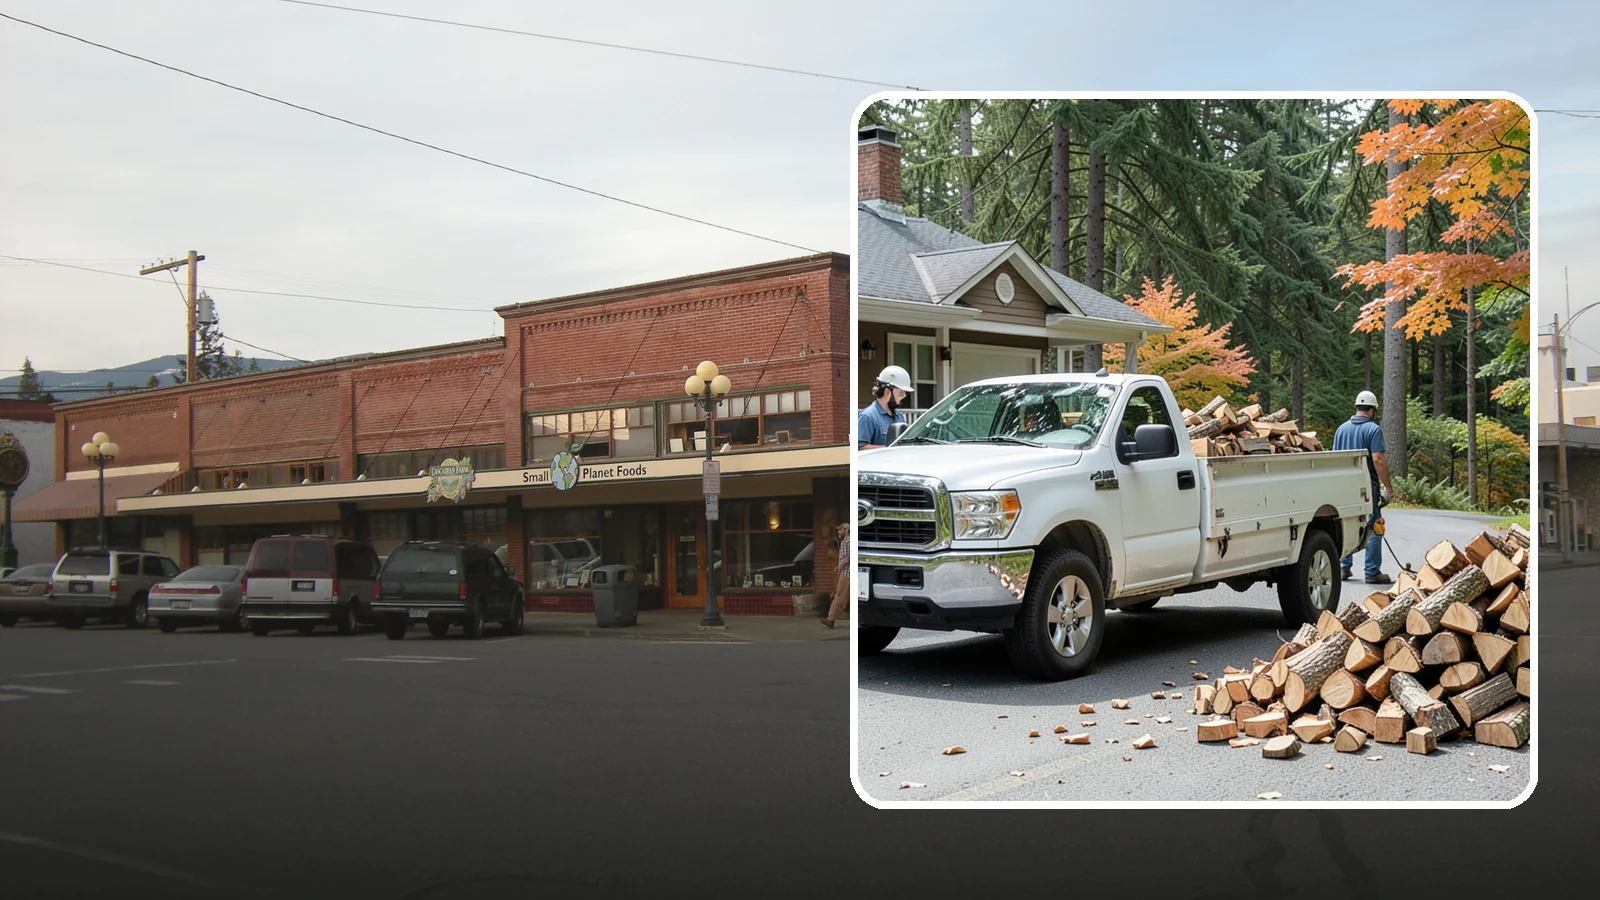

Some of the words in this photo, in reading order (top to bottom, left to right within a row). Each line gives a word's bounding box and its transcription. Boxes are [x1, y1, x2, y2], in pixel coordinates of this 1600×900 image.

[431, 467, 456, 476] CASCADIAN
[523, 471, 548, 482] Small
[583, 467, 614, 479] Planet
[617, 464, 647, 476] Foods
